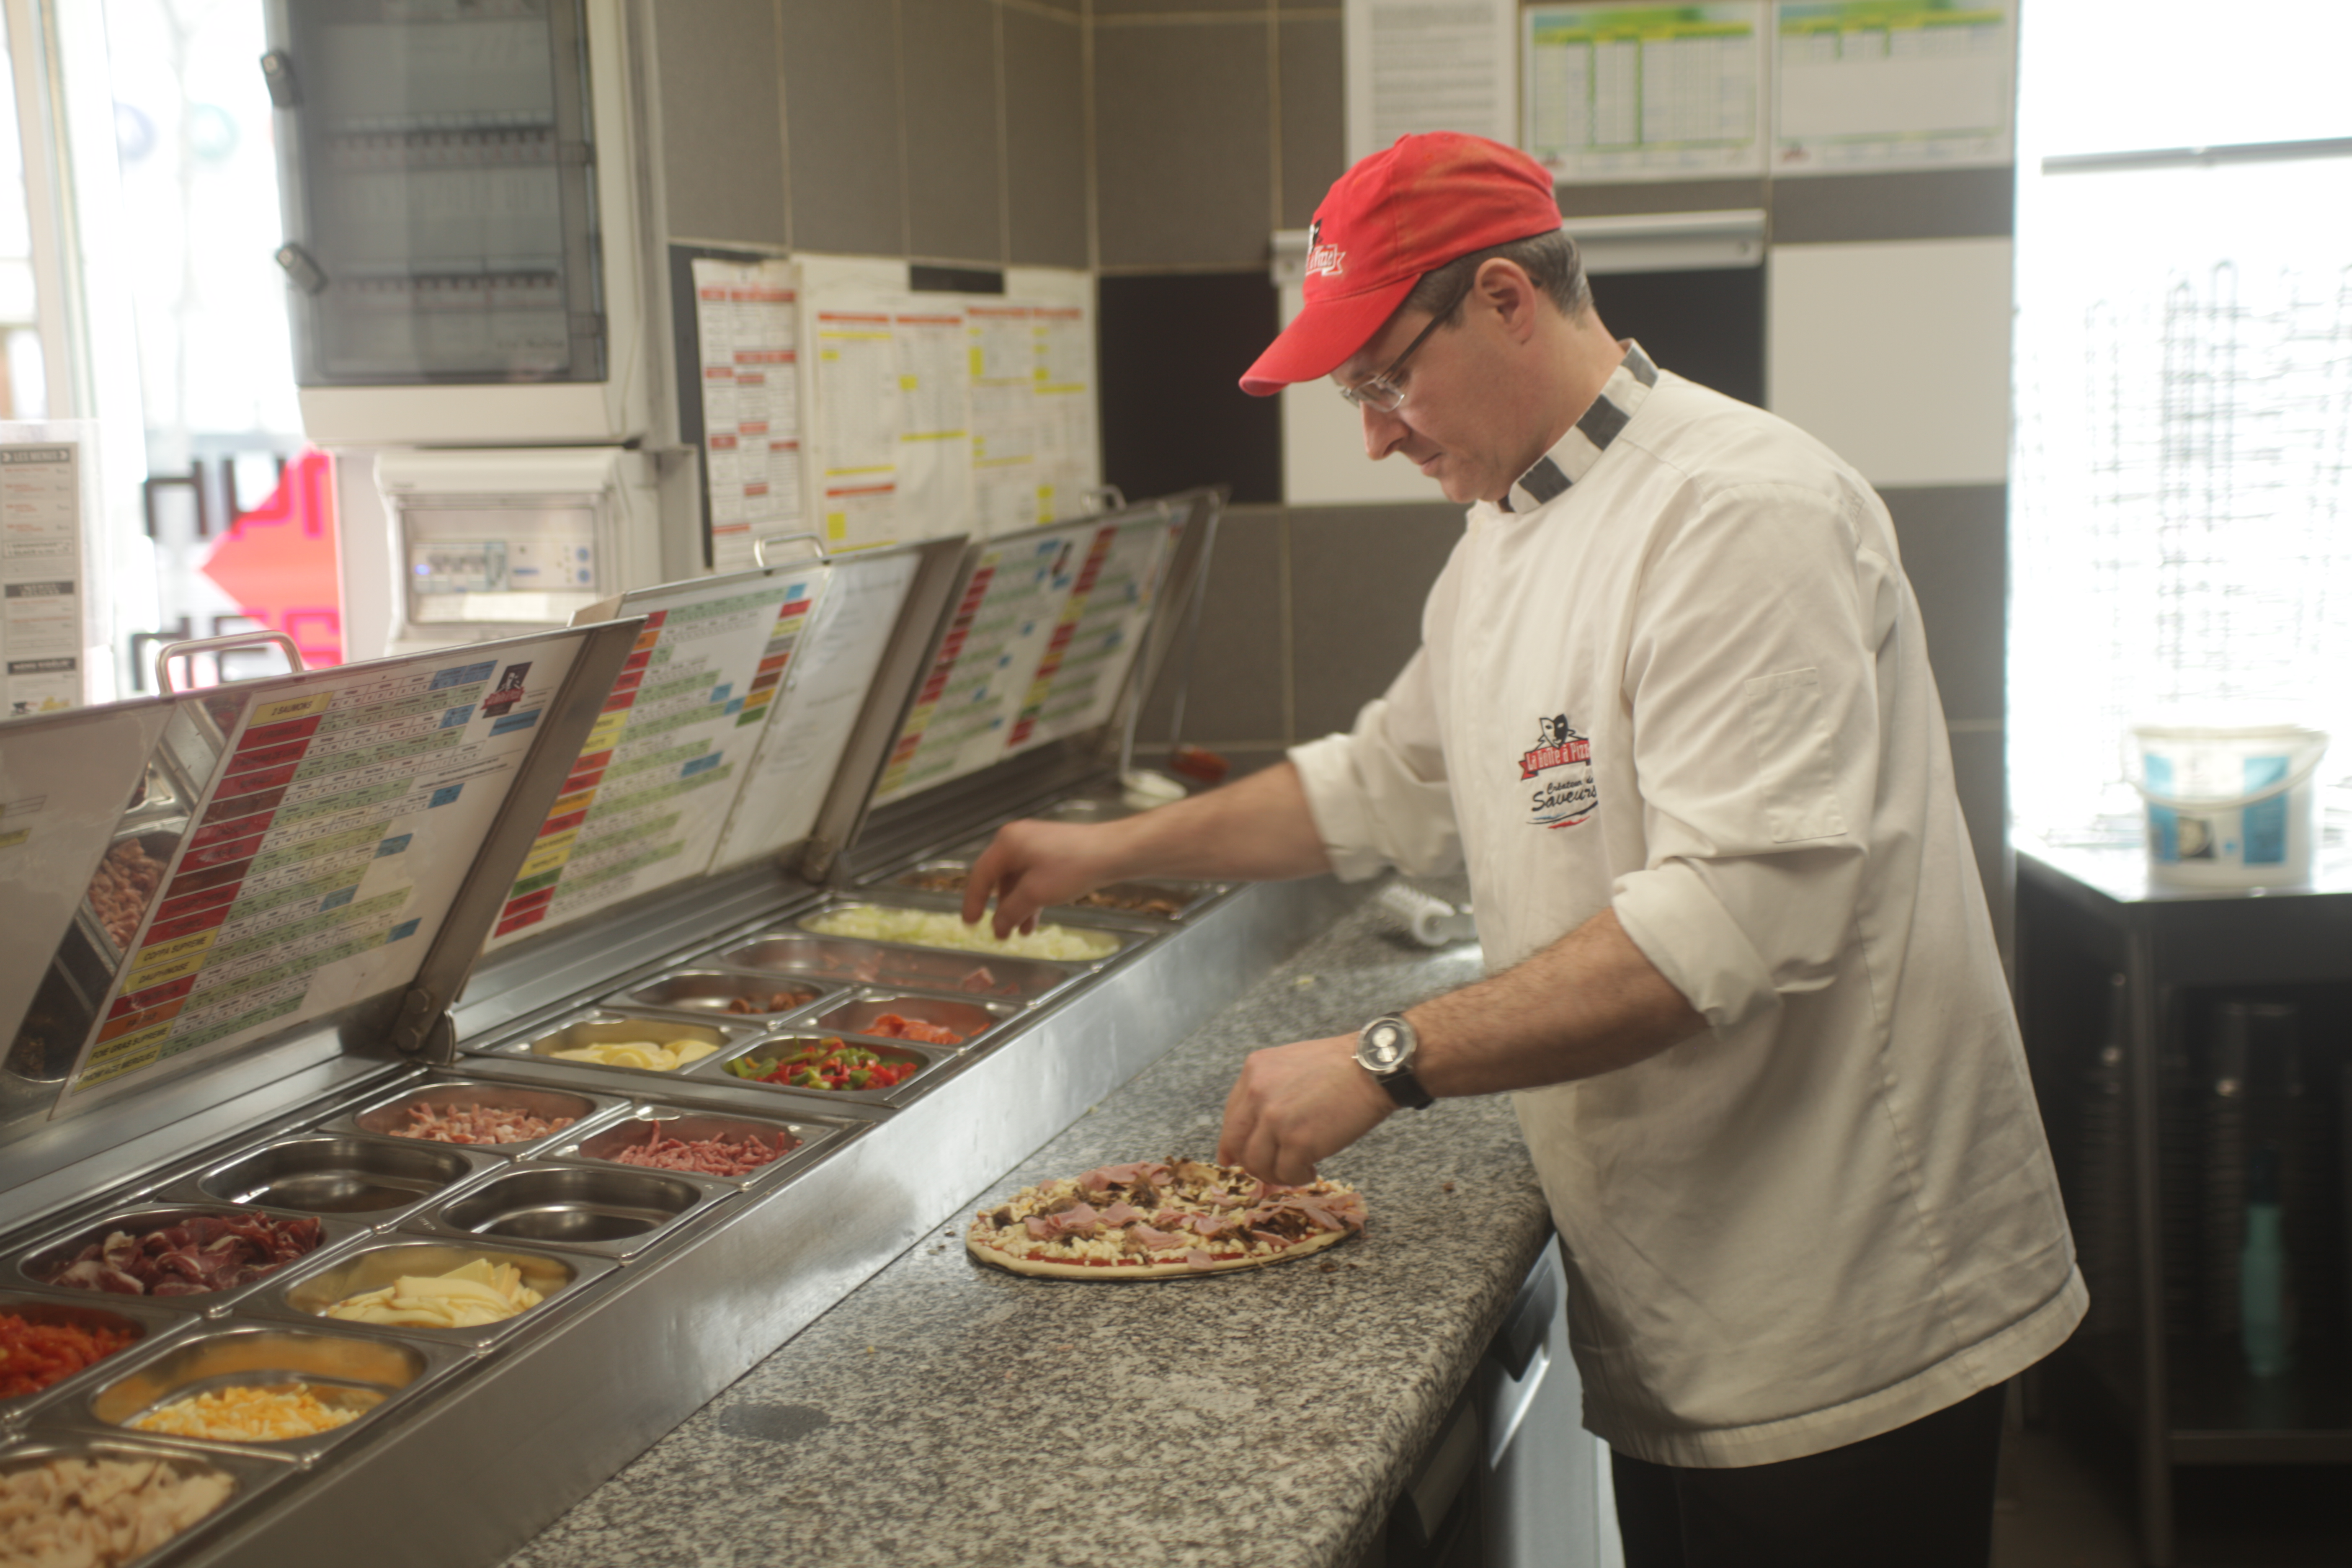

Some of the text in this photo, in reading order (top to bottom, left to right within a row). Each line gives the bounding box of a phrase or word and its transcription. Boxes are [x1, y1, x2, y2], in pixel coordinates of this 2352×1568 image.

[277, 701, 312, 714] SAUMONS
[1526, 752, 1537, 771] La
[1537, 747, 1560, 768] Boîte
[1532, 784, 1597, 812] Saveurs
[143, 936, 208, 961] COPPA SUPREME
[138, 962, 189, 984] DAUPHINOISE
[111, 1041, 132, 1056] GRAS
